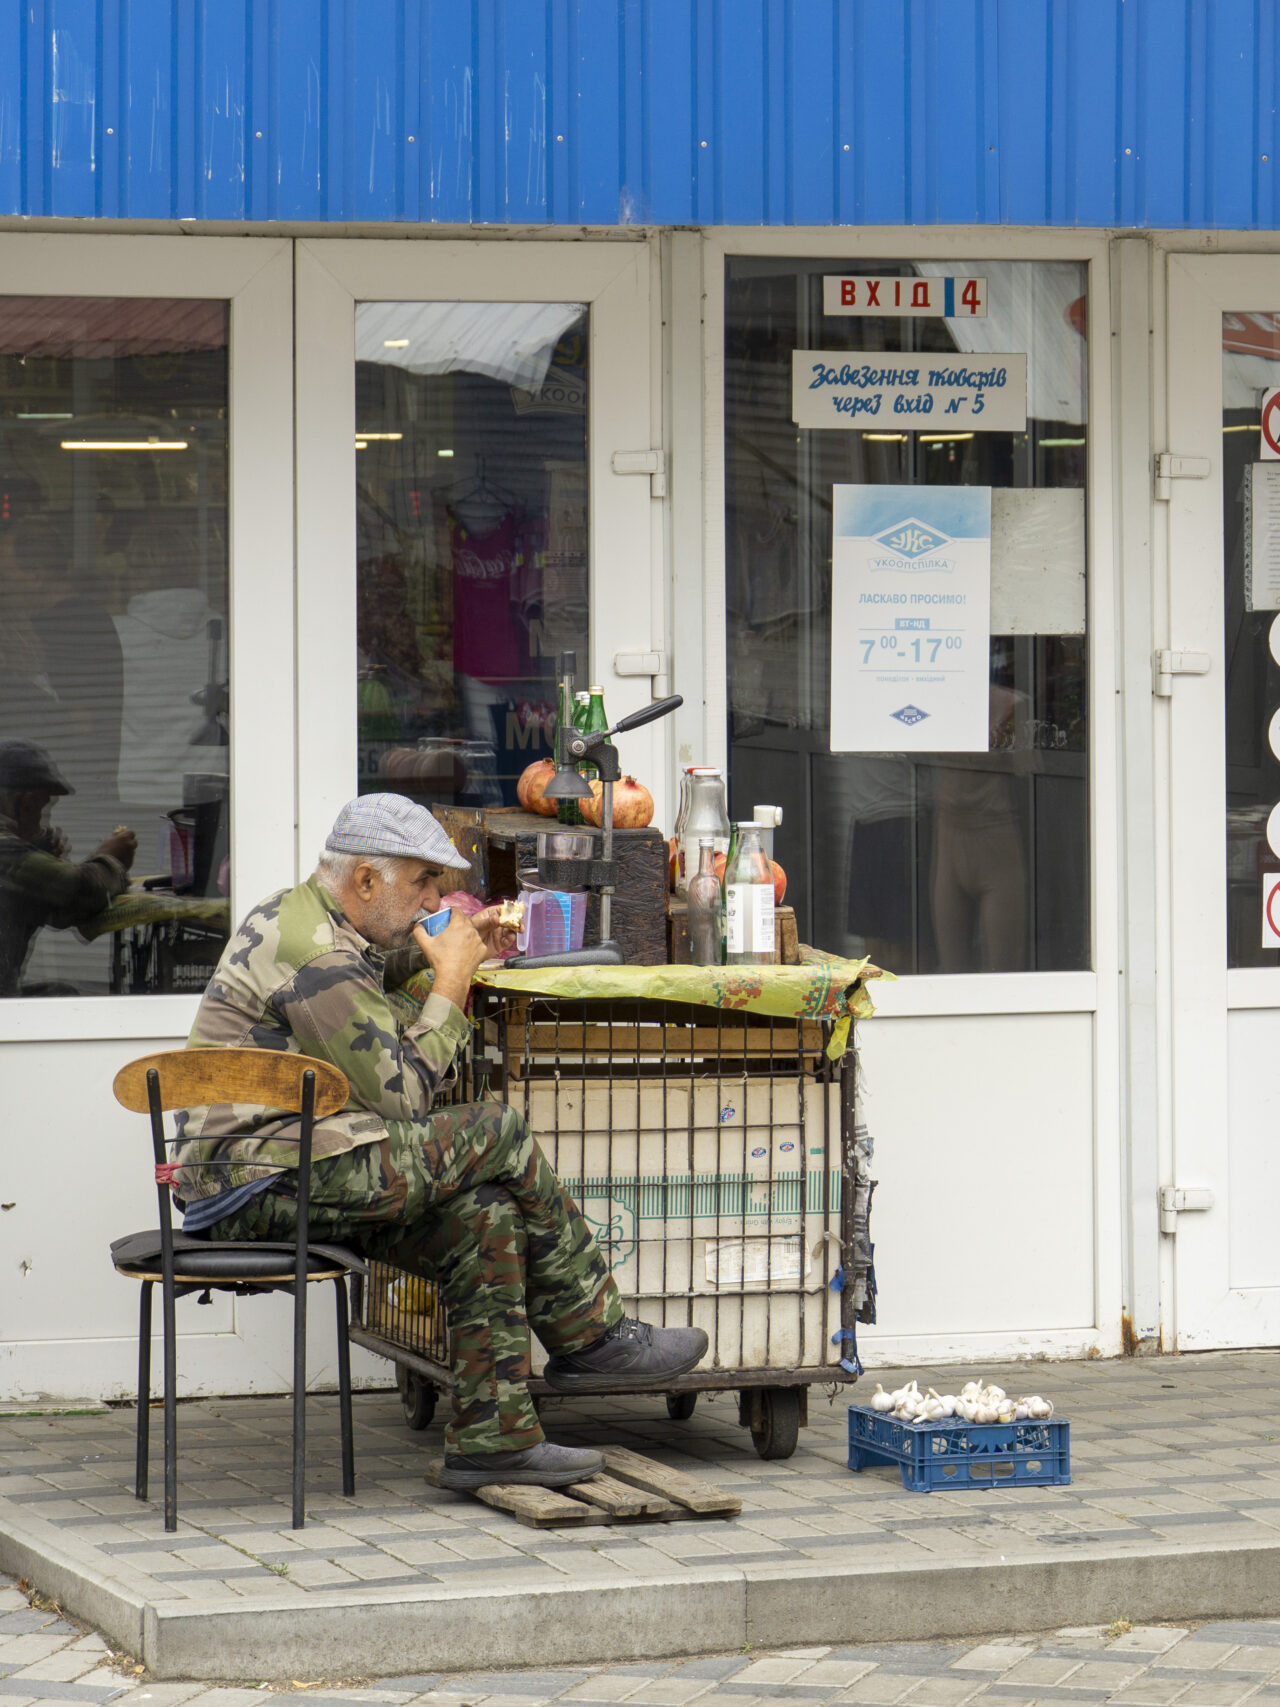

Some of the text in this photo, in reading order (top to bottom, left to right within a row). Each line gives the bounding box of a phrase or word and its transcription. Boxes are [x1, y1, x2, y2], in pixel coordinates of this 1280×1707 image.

[841, 280, 981, 314] ВХІД 4
[808, 363, 1007, 391] Завезення товарів
[832, 394, 882, 417] через
[893, 393, 933, 414] вхід
[874, 559, 948, 570] УКООПСПІЛКА
[858, 593, 967, 605] ЛАСКАВО ПРОСИМО!
